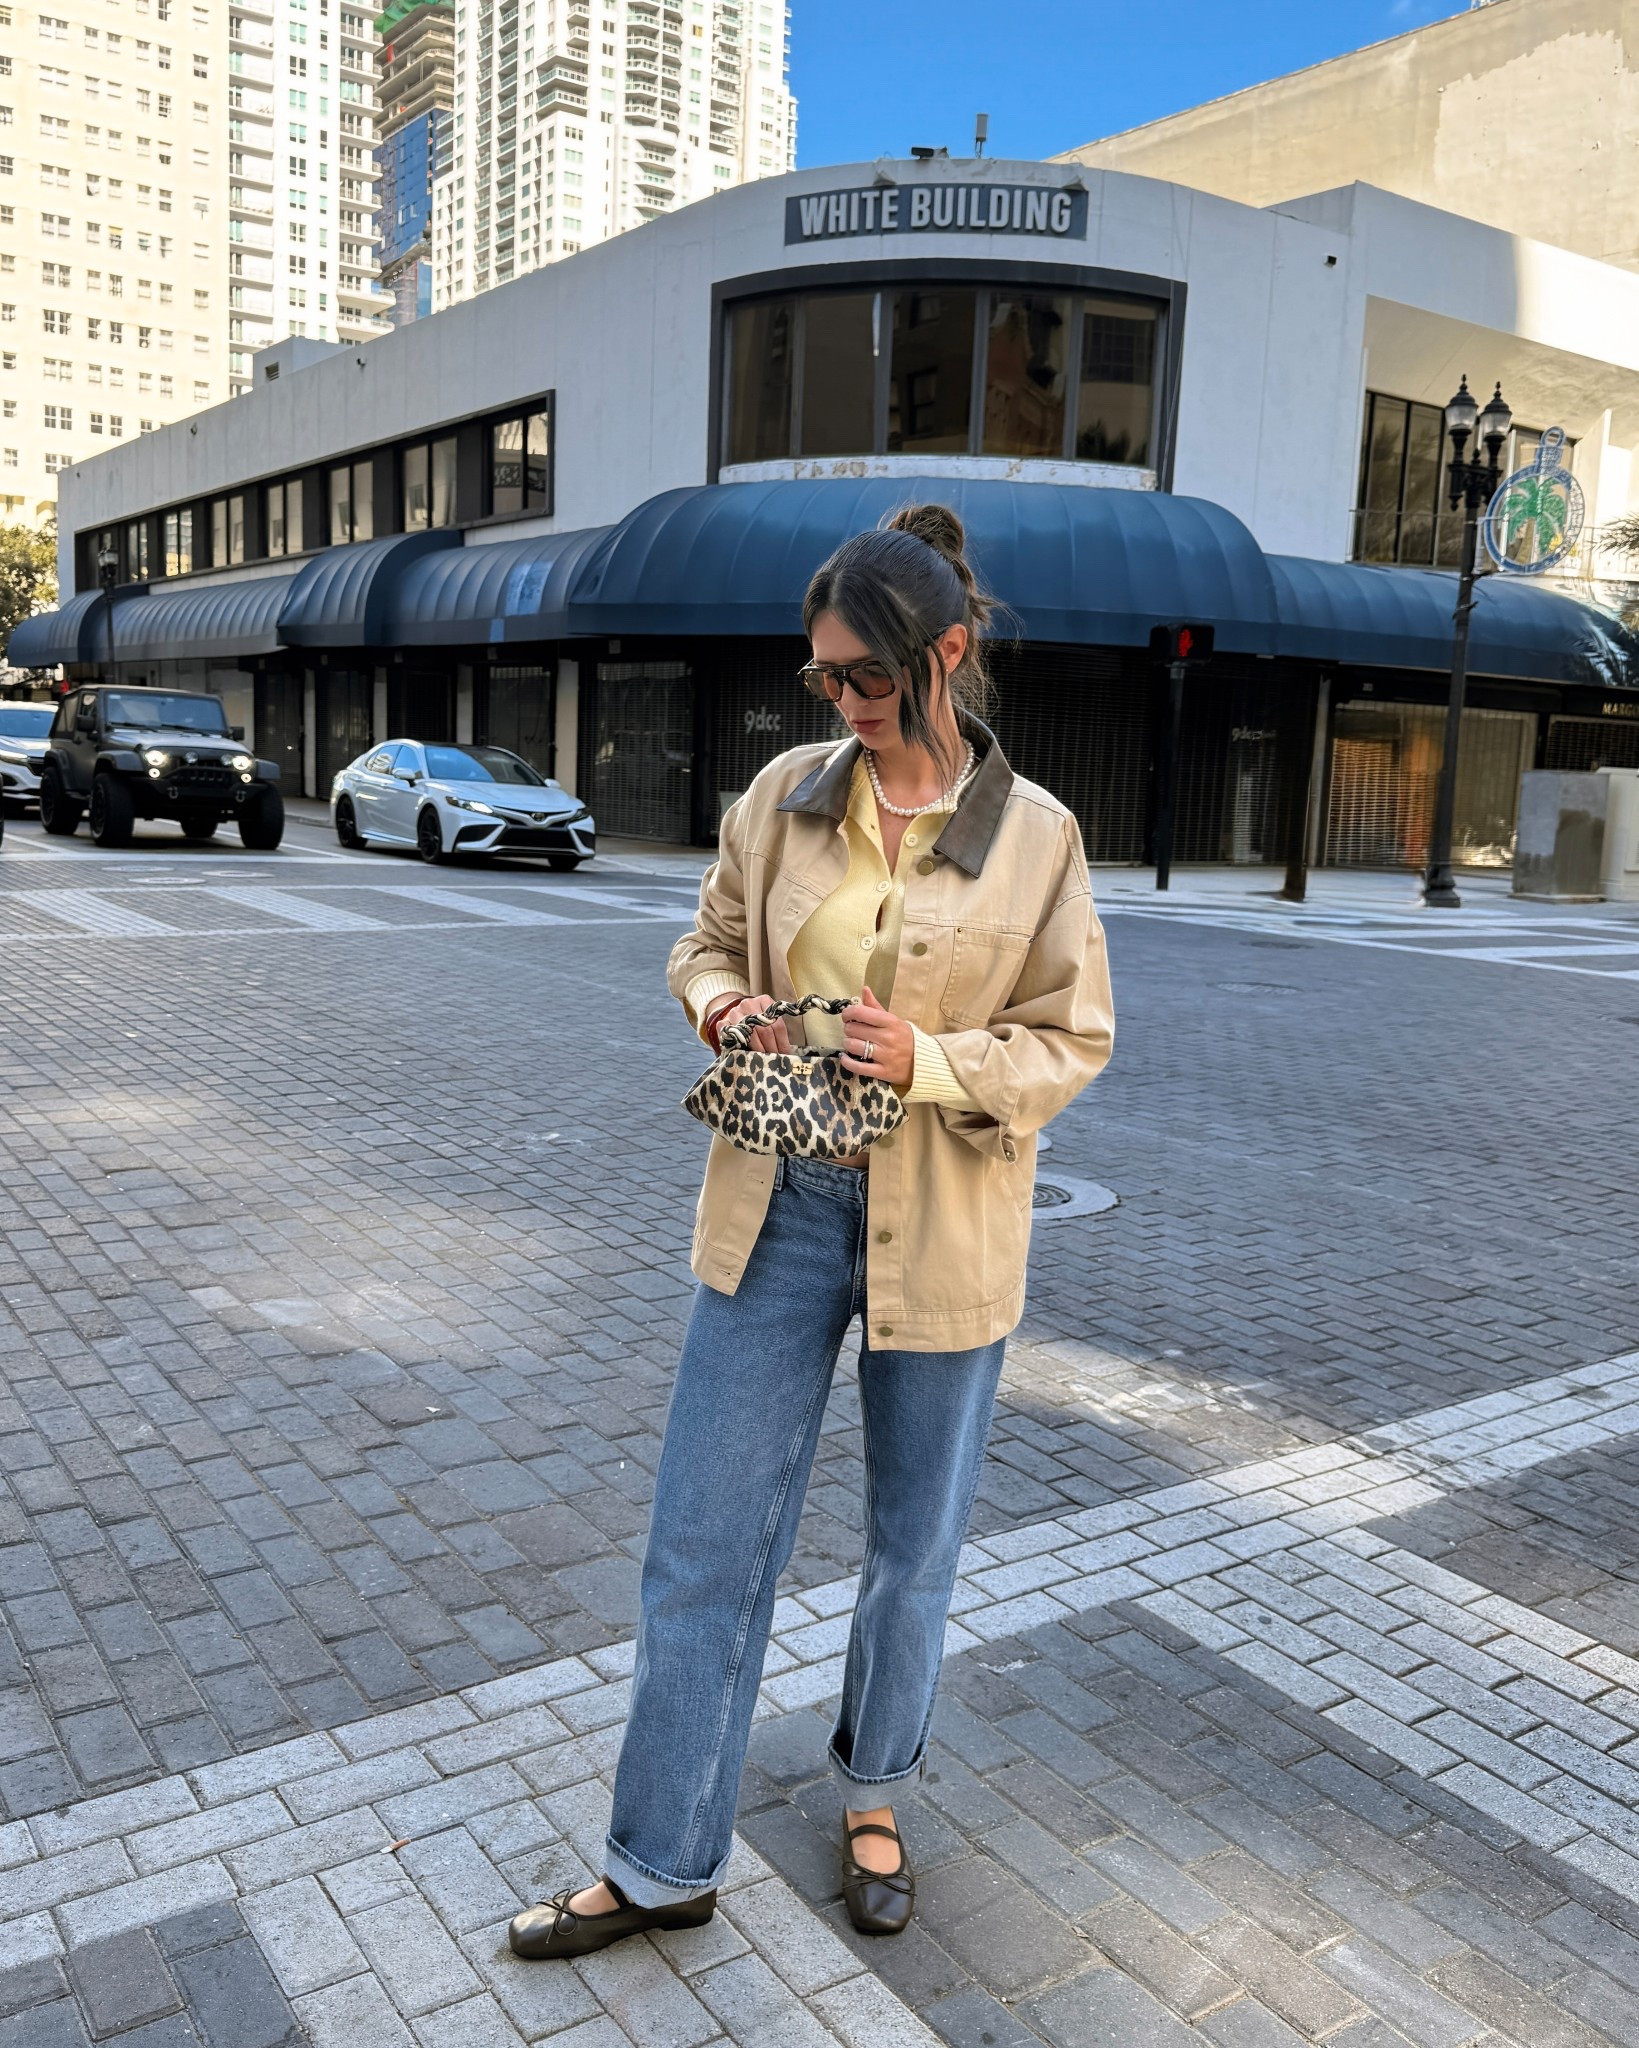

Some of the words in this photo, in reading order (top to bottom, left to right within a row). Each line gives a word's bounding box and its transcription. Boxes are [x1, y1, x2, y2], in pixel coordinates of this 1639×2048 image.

[800, 189, 899, 236] WHITE
[910, 187, 1072, 233] BUILDING
[744, 706, 781, 734] 9dcc
